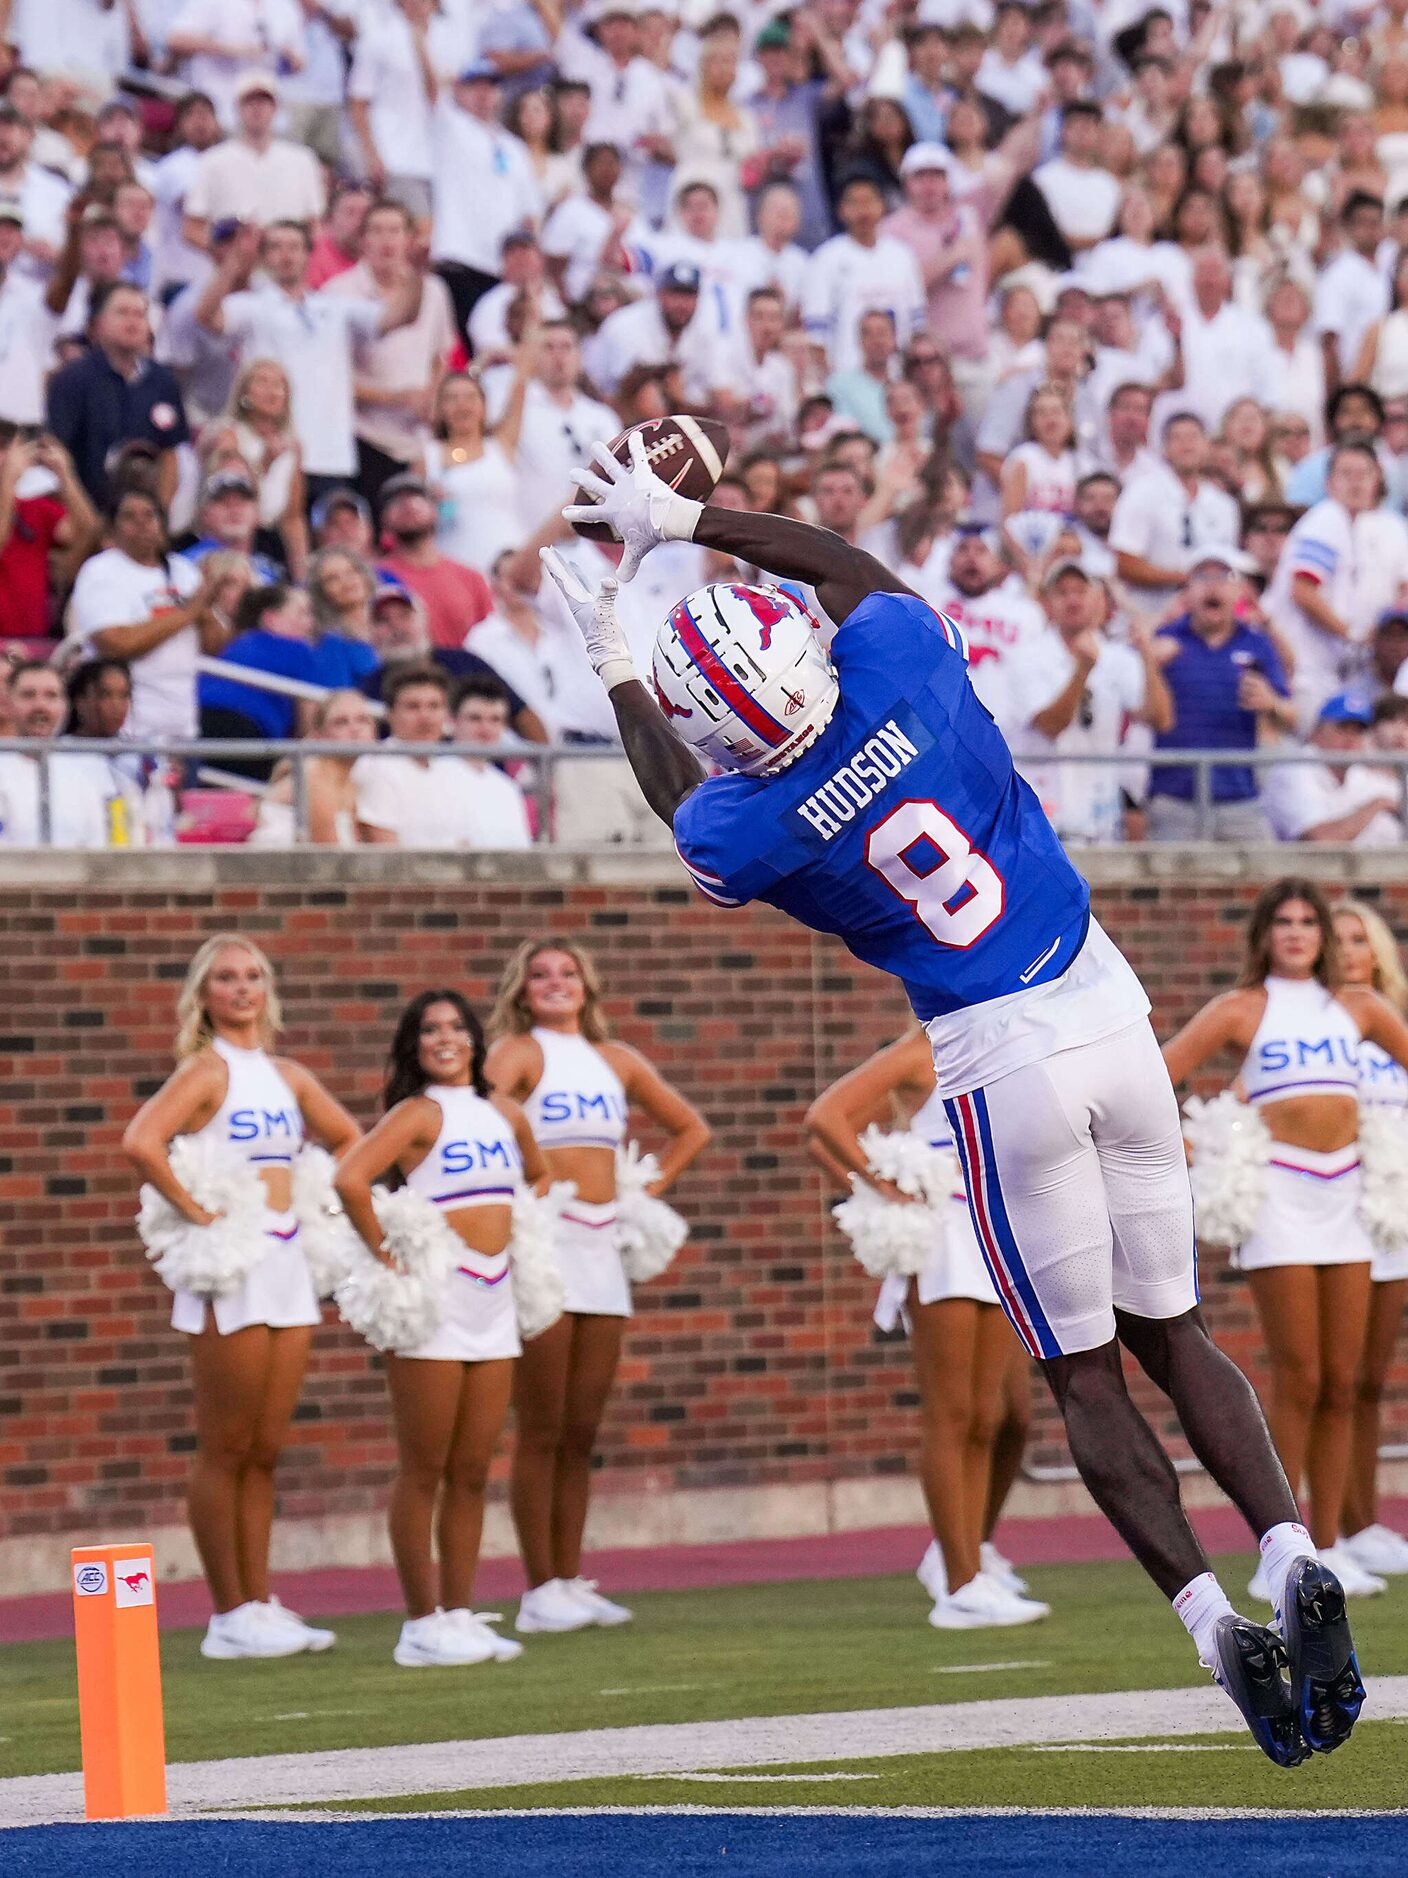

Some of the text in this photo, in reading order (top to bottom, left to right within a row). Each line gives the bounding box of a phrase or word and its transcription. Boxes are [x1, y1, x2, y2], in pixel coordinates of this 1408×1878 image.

[797, 719, 919, 841] HUDSON
[864, 798, 1005, 950] 8
[1260, 1037, 1360, 1071] SMU
